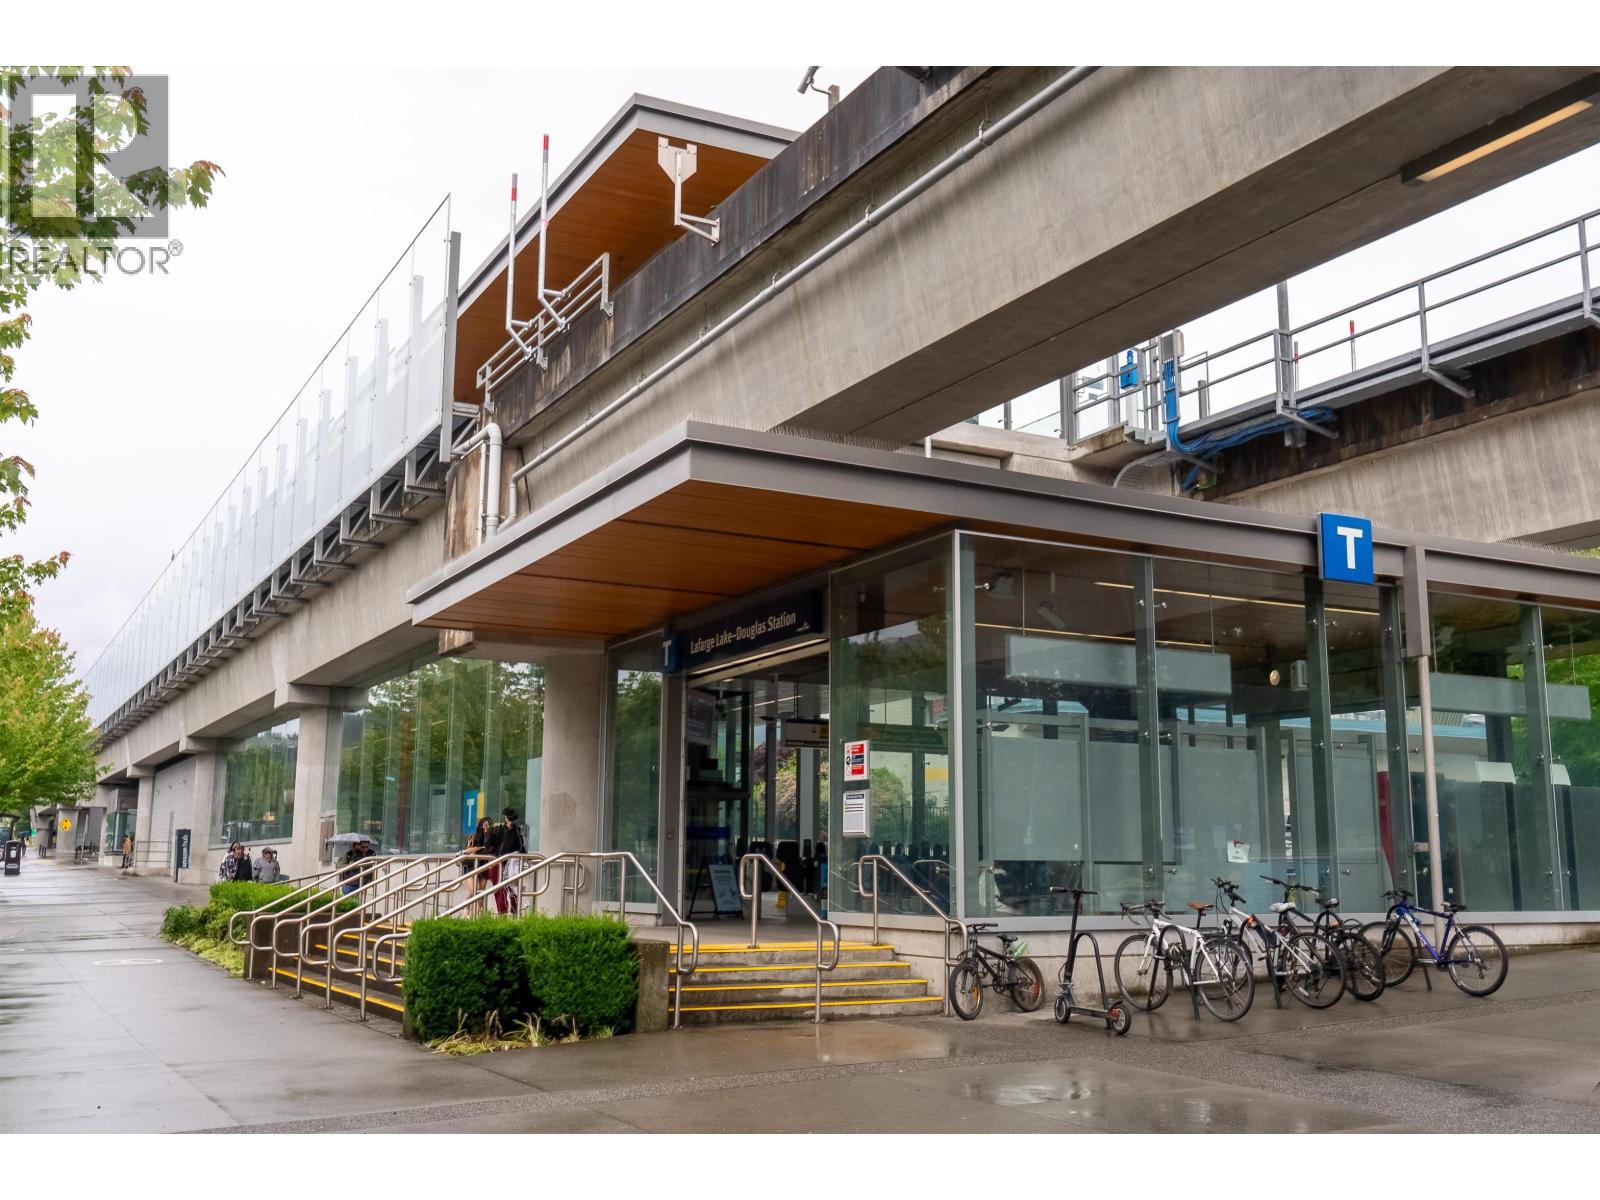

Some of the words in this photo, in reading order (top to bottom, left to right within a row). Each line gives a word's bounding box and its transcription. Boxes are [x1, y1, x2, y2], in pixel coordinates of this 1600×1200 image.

[1336, 526, 1363, 570] T
[662, 639, 672, 667] T
[690, 637, 715, 655] Lafarge
[767, 611, 797, 632] Station
